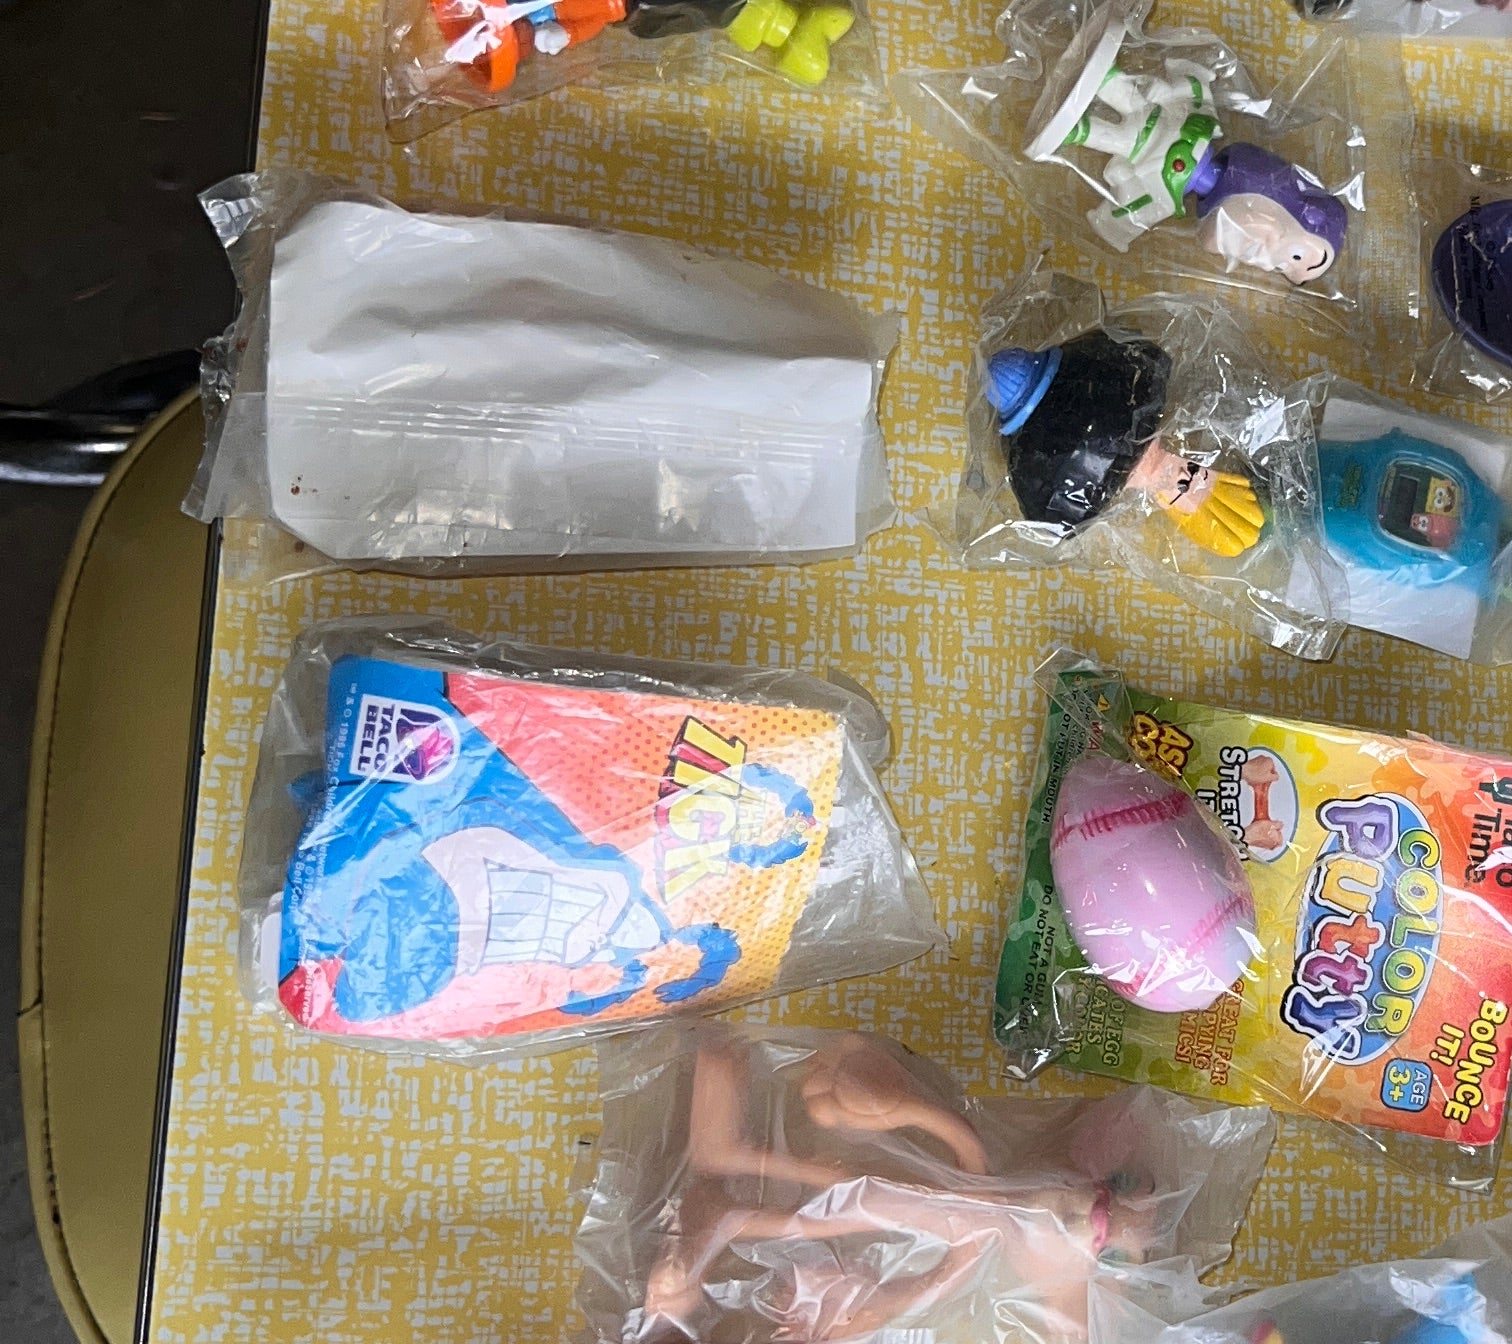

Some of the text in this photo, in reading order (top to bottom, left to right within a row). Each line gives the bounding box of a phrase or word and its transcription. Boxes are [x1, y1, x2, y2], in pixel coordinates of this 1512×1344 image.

[358, 704, 378, 772] BELL
[373, 704, 395, 773] TACO
[654, 716, 747, 904] TICK
[1041, 779, 1059, 824] MOUTH.
[1465, 809, 1502, 884] Time
[1023, 884, 1054, 994] DO NOT EAT OR
[1040, 926, 1057, 968] NOT A
[1281, 796, 1399, 1060] Putty
[1364, 829, 1440, 1038] COLOR
[1103, 1032, 1124, 1066] EGG
[1210, 1047, 1234, 1085] FOR
[1430, 1023, 1465, 1067] IT!
[1442, 999, 1509, 1124] BOUNCE
[1387, 1066, 1411, 1102] 3+
[1411, 1070, 1426, 1105] AGE
